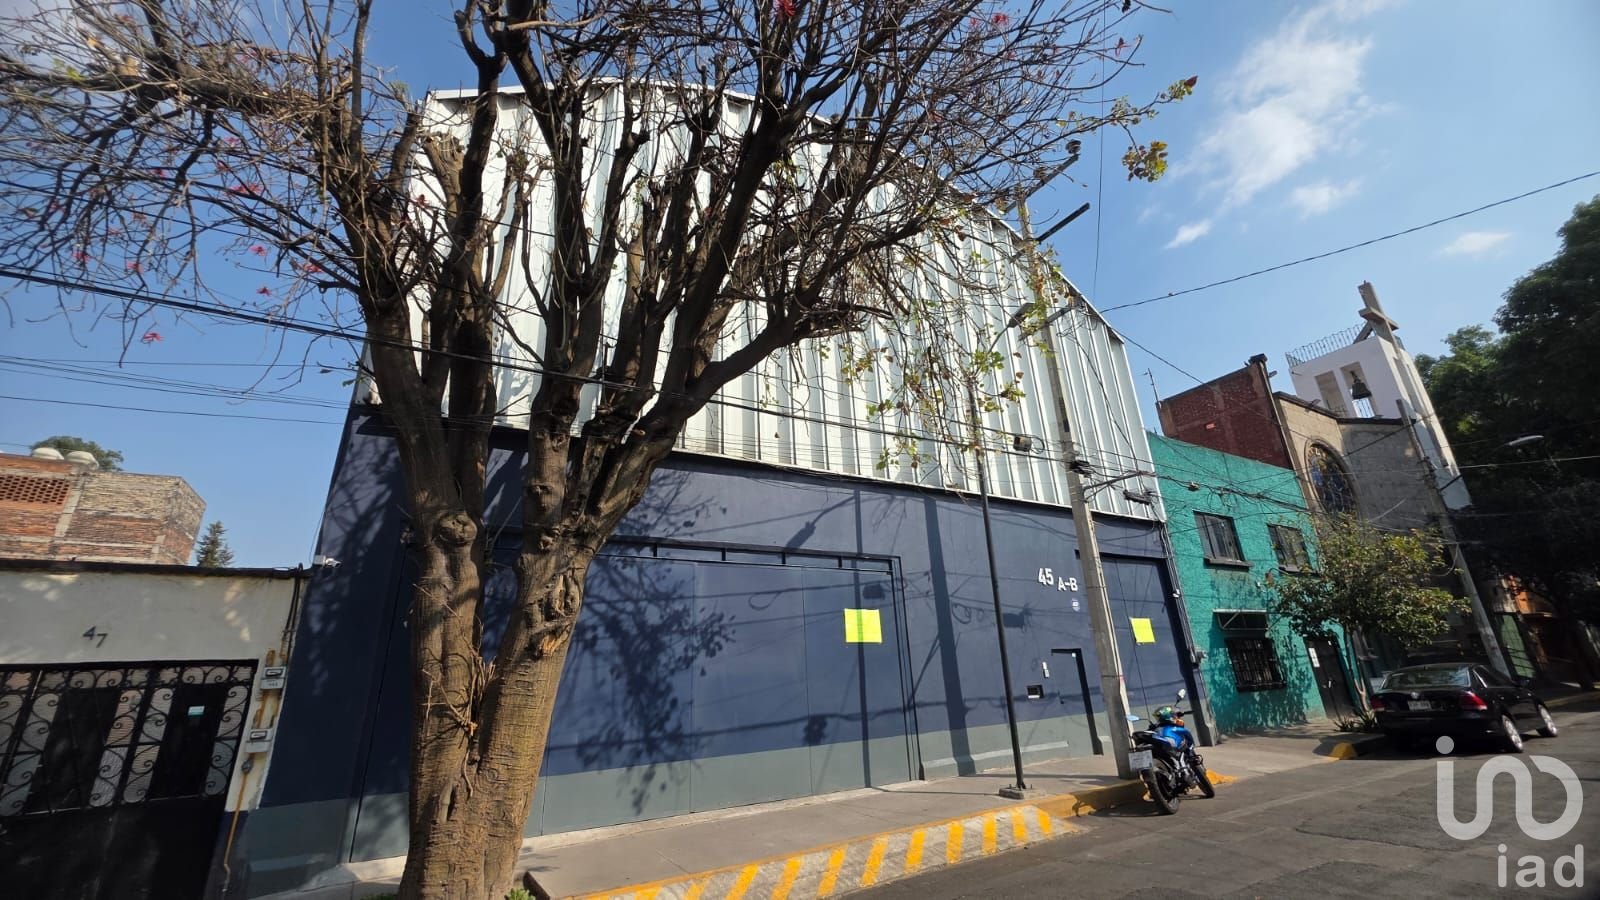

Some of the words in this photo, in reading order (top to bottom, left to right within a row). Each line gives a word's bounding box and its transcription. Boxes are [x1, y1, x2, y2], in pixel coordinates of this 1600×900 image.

[1038, 567, 1054, 586] 45
[1057, 576, 1078, 592] A-B
[82, 626, 108, 648] 47
